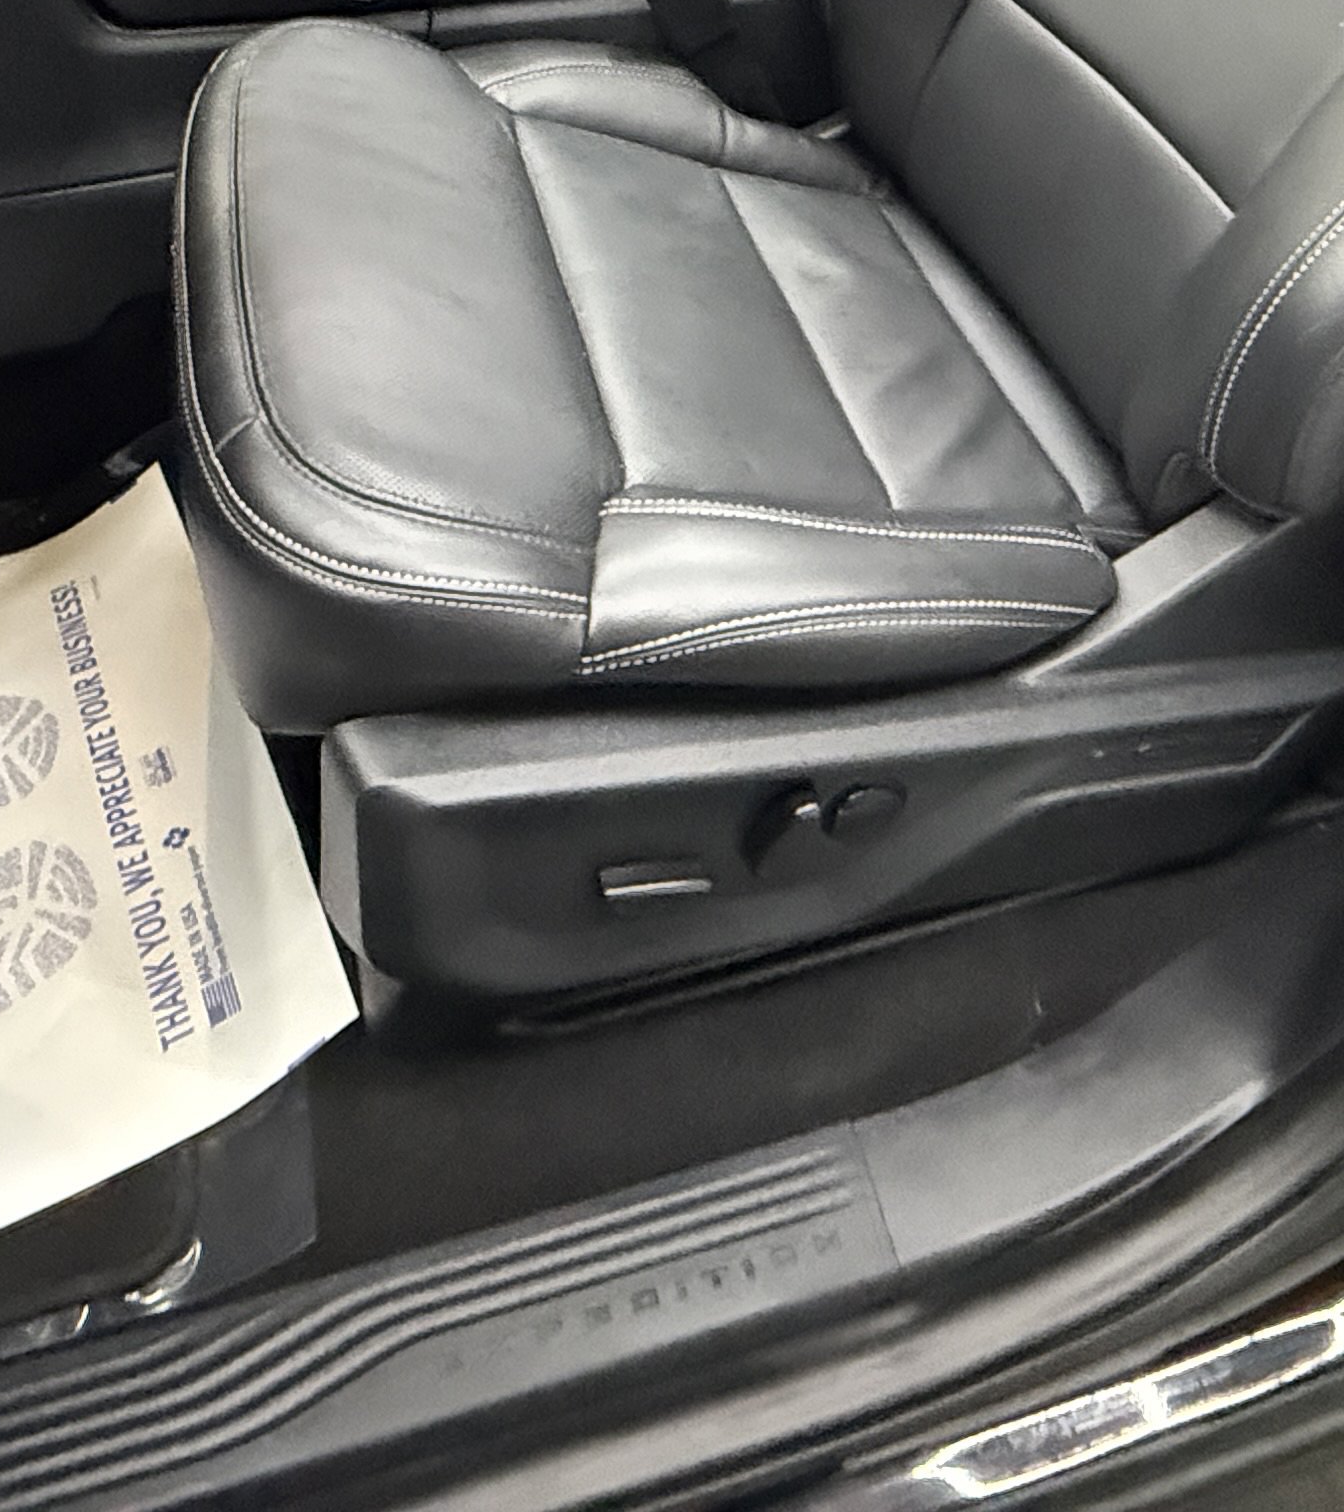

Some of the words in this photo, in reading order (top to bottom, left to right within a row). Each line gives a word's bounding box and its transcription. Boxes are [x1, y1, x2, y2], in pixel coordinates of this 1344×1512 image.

[51, 580, 98, 676] BUSINESS!
[73, 672, 112, 730] YOUR
[85, 726, 145, 849] APPRECIATE
[117, 849, 155, 896] WE
[128, 886, 172, 960] YOU,
[143, 952, 195, 1052] THANK
